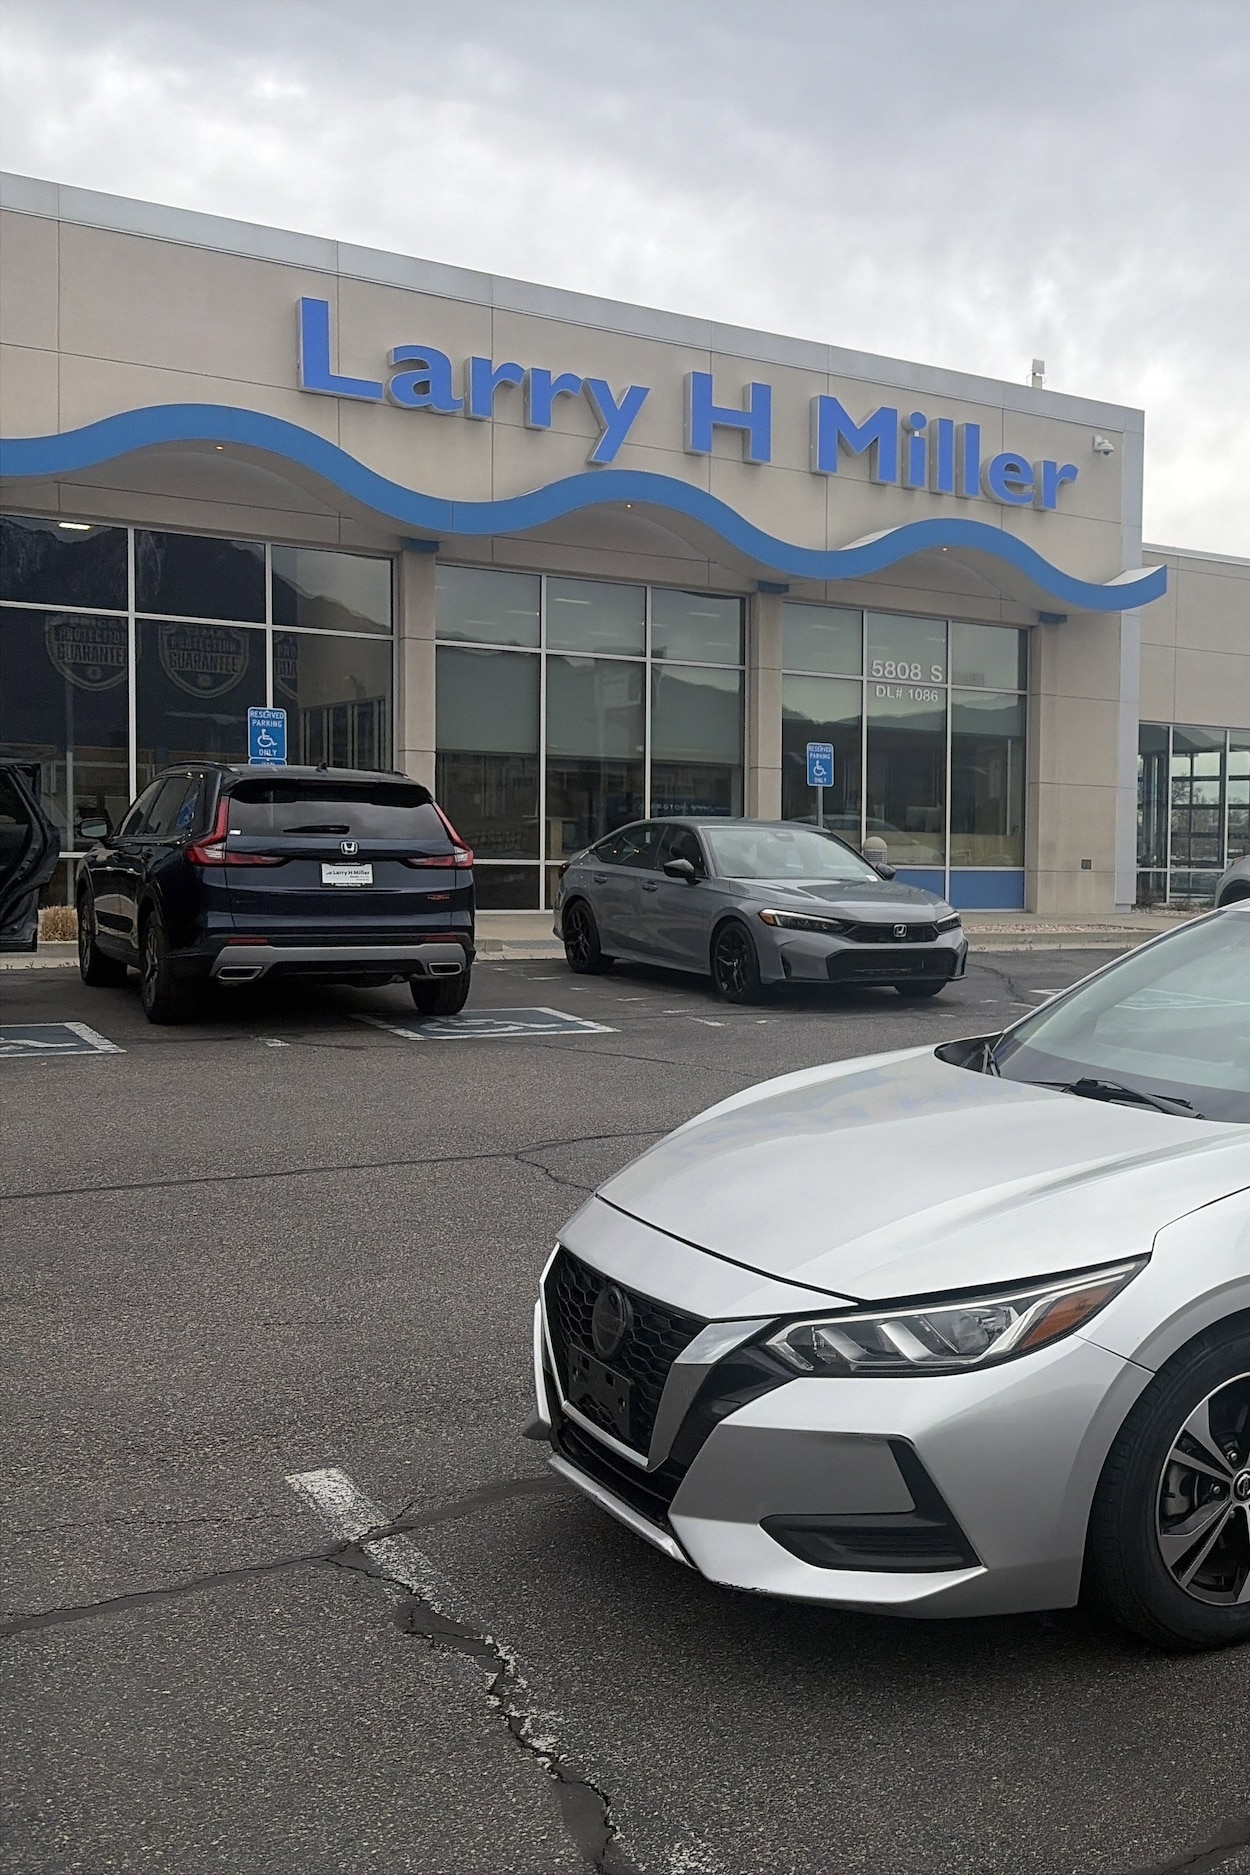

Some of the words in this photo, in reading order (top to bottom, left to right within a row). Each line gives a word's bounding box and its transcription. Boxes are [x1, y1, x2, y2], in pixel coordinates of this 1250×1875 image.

[297, 296, 651, 464] Larry
[685, 371, 771, 464] H
[811, 395, 1079, 510] Miller
[170, 651, 240, 674] GUARANTEE
[871, 660, 922, 680] 5808
[930, 664, 943, 682] S
[876, 684, 903, 699] DL#
[908, 687, 939, 702] 1086
[250, 710, 284, 719] RESERVED
[252, 719, 283, 728] PARKING
[259, 748, 278, 756] ONLY
